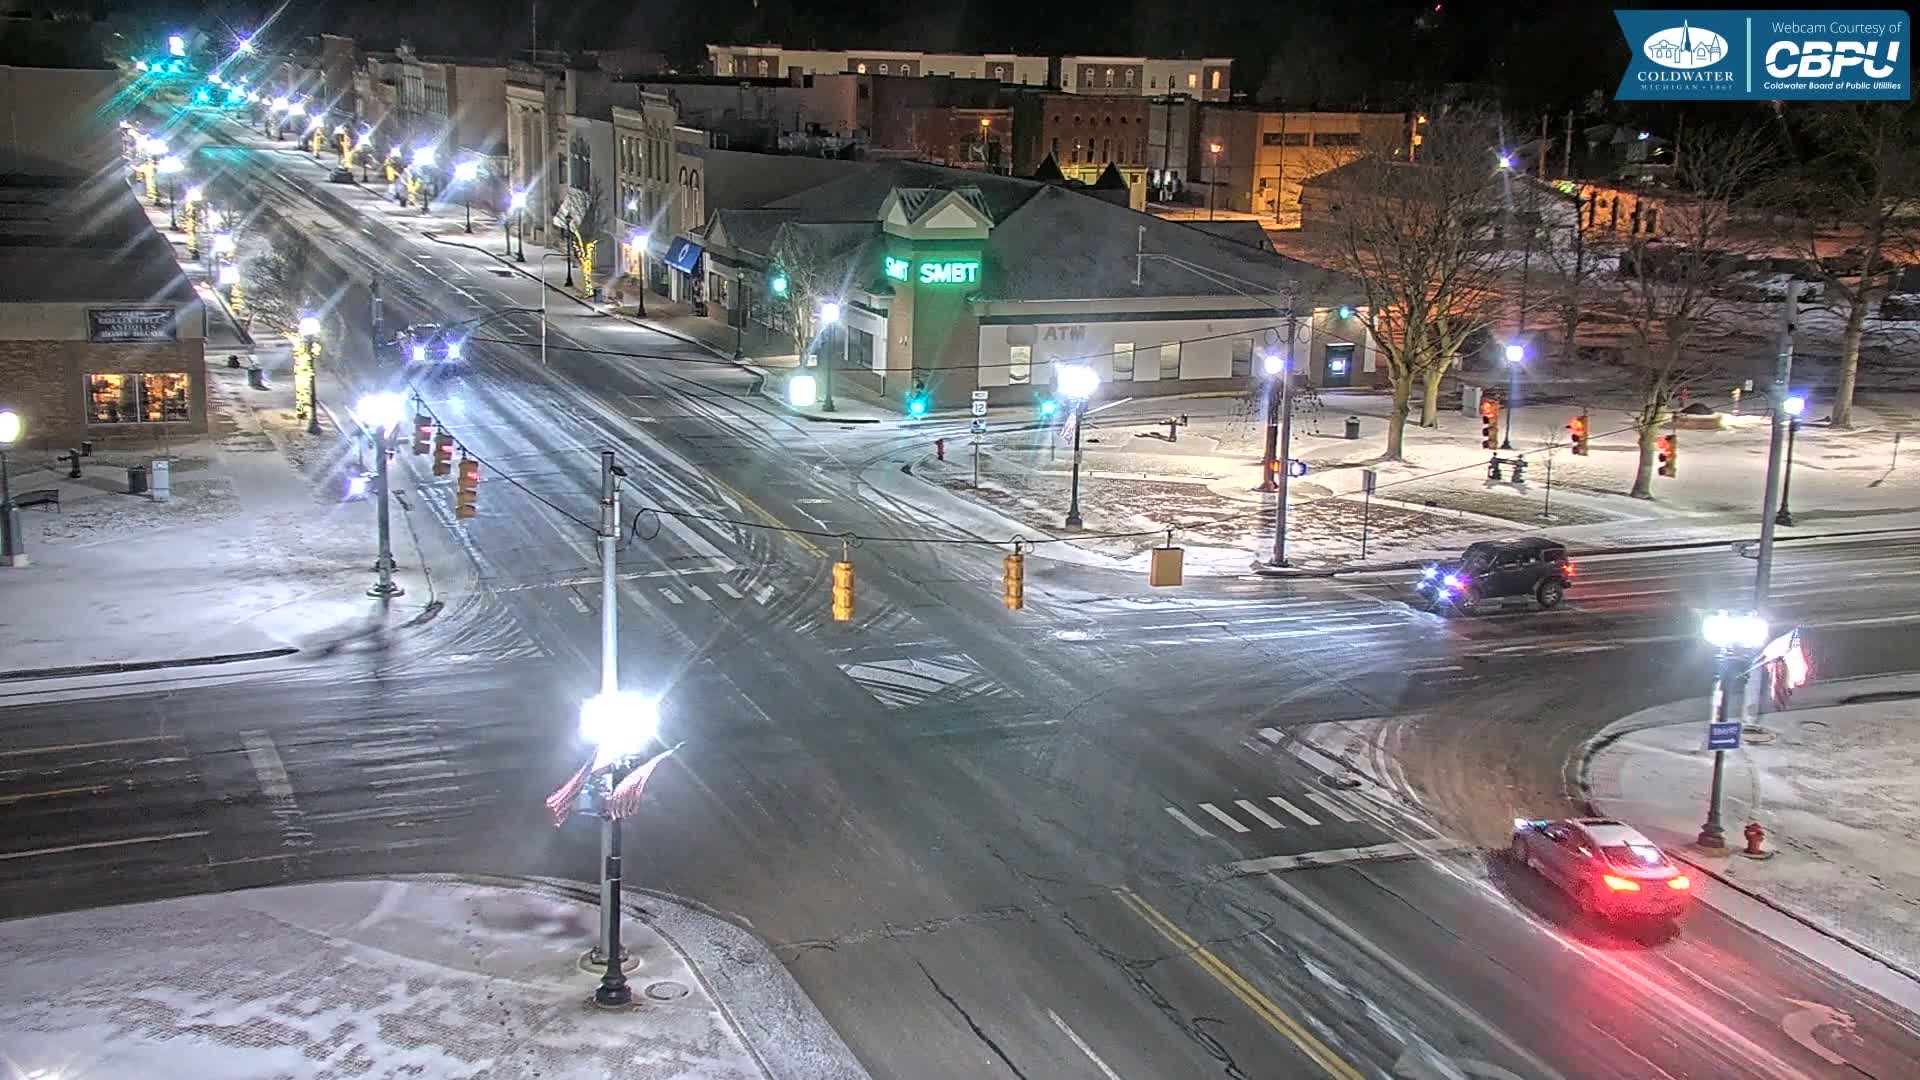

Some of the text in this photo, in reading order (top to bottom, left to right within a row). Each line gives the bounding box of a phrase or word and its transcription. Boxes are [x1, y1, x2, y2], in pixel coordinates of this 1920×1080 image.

[919, 261, 979, 284] SMBT
[1042, 325, 1087, 341] ATM
[975, 403, 984, 413] 12
